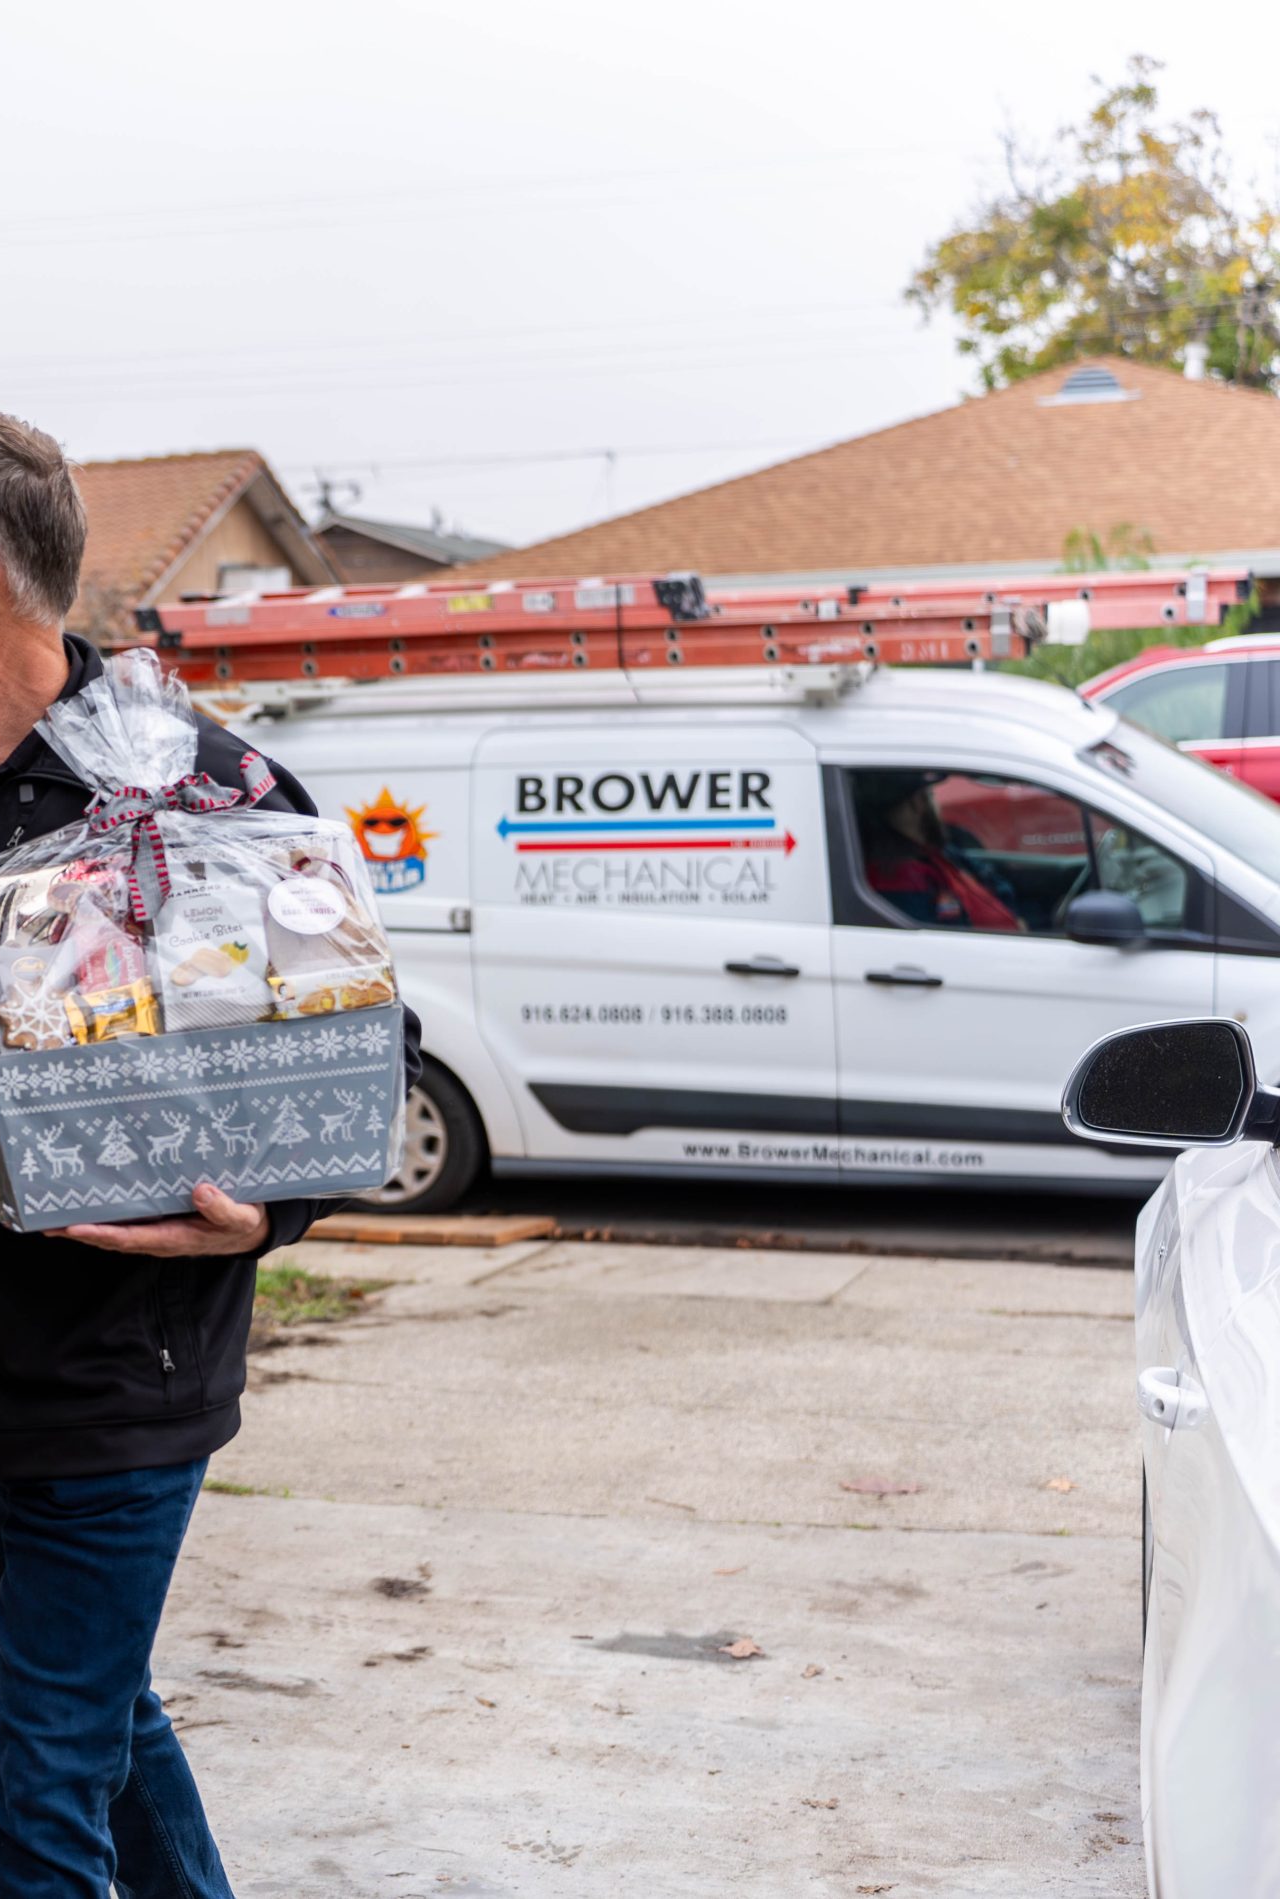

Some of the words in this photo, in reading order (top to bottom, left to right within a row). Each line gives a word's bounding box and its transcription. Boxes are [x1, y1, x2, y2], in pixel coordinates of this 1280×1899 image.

[517, 772, 771, 813] BROWER
[515, 857, 776, 891] MECHANICAL
[520, 892, 553, 904] HEAT
[575, 891, 598, 903] AIR
[618, 891, 700, 904] INSULATION
[721, 890, 769, 903] SOLAR
[184, 906, 223, 918] LEMON
[169, 931, 210, 947] Cookie
[212, 924, 243, 936] Bites
[683, 1141, 983, 1167] www.BrowerMechanical.com
